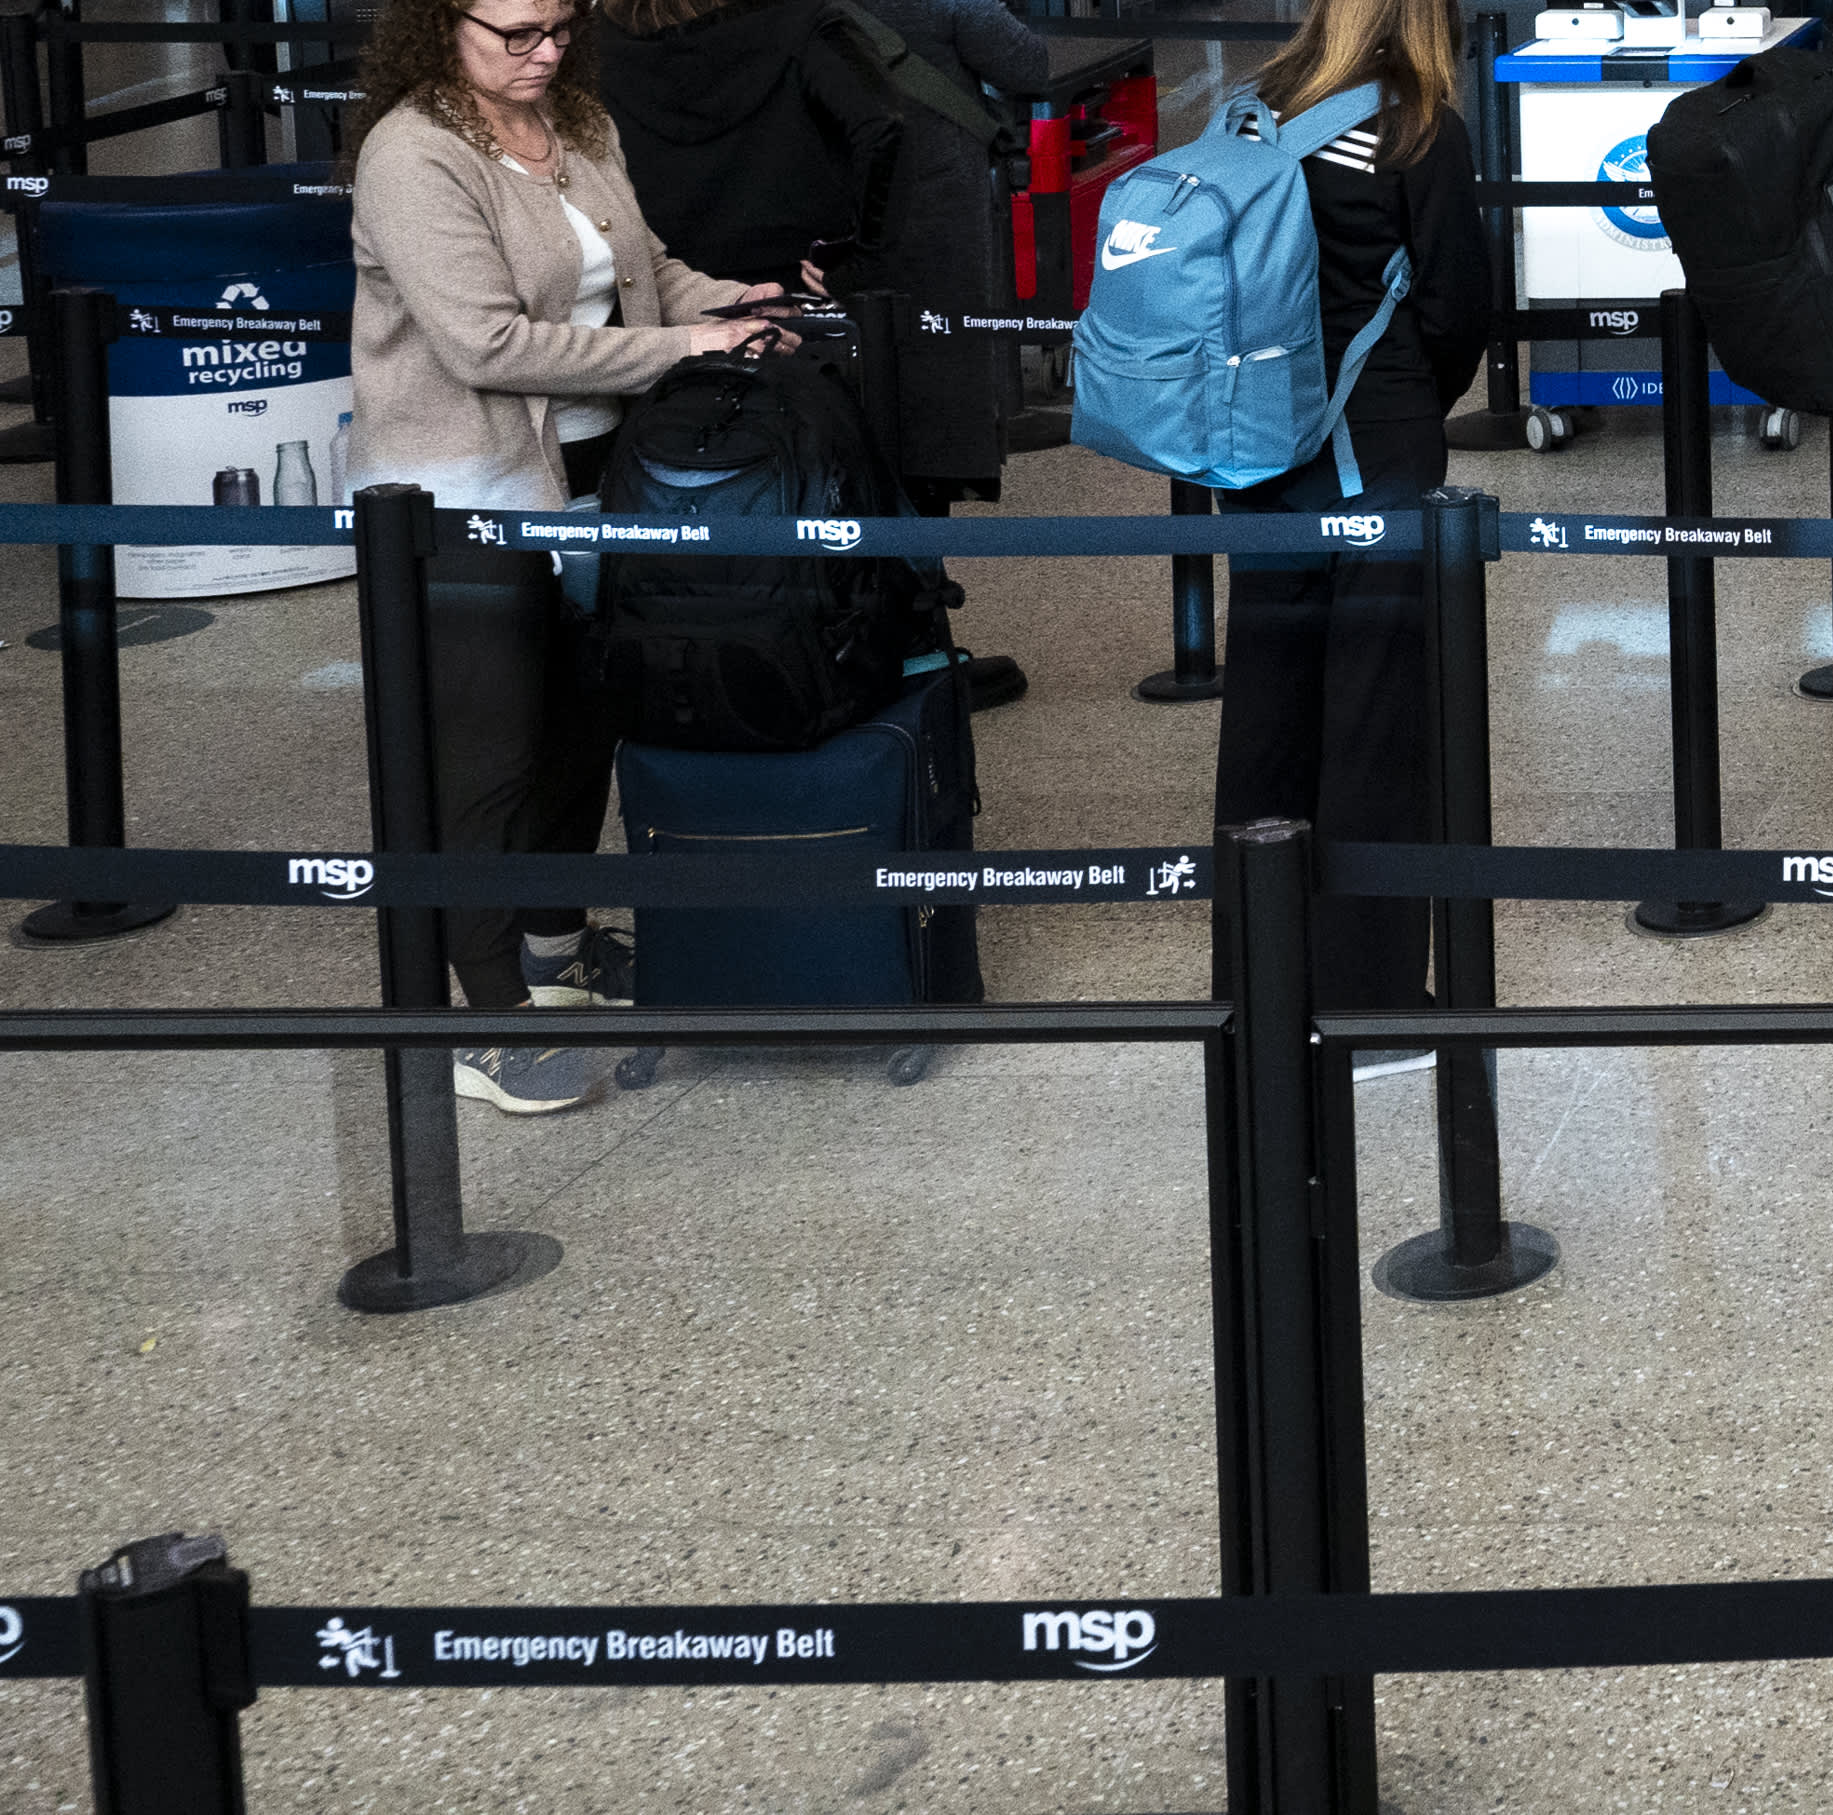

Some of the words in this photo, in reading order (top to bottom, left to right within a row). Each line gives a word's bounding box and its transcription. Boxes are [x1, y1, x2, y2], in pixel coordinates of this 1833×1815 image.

[304, 88, 347, 102] Emergency
[7, 177, 49, 193] msp
[1110, 218, 1161, 253] NIKE
[173, 315, 234, 331] Emergency
[236, 316, 297, 333] Breakaway
[299, 319, 322, 332] Belt
[963, 315, 1024, 331] Emergency
[1026, 317, 1080, 330] Breakawa
[1590, 310, 1639, 328] msp
[189, 361, 303, 386] recycling
[1641, 382, 1664, 395] IDE
[228, 398, 268, 413] msp
[521, 521, 599, 544] Emergency
[602, 523, 679, 545] Breakaway
[681, 525, 710, 542] Belt
[796, 518, 862, 544] msp
[1320, 514, 1385, 540] msp
[1584, 524, 1662, 545] Emergency
[1665, 527, 1741, 547] Breakaway
[1744, 528, 1772, 544] Belt
[287, 857, 374, 892] msp
[875, 867, 978, 892] Emergency
[982, 866, 1085, 890] Breakaway
[1088, 864, 1125, 885] Belt
[1022, 1608, 1156, 1660] msp
[434, 1629, 600, 1667] Emergency
[606, 1627, 769, 1665] Breakaway
[776, 1626, 836, 1660] Belt
